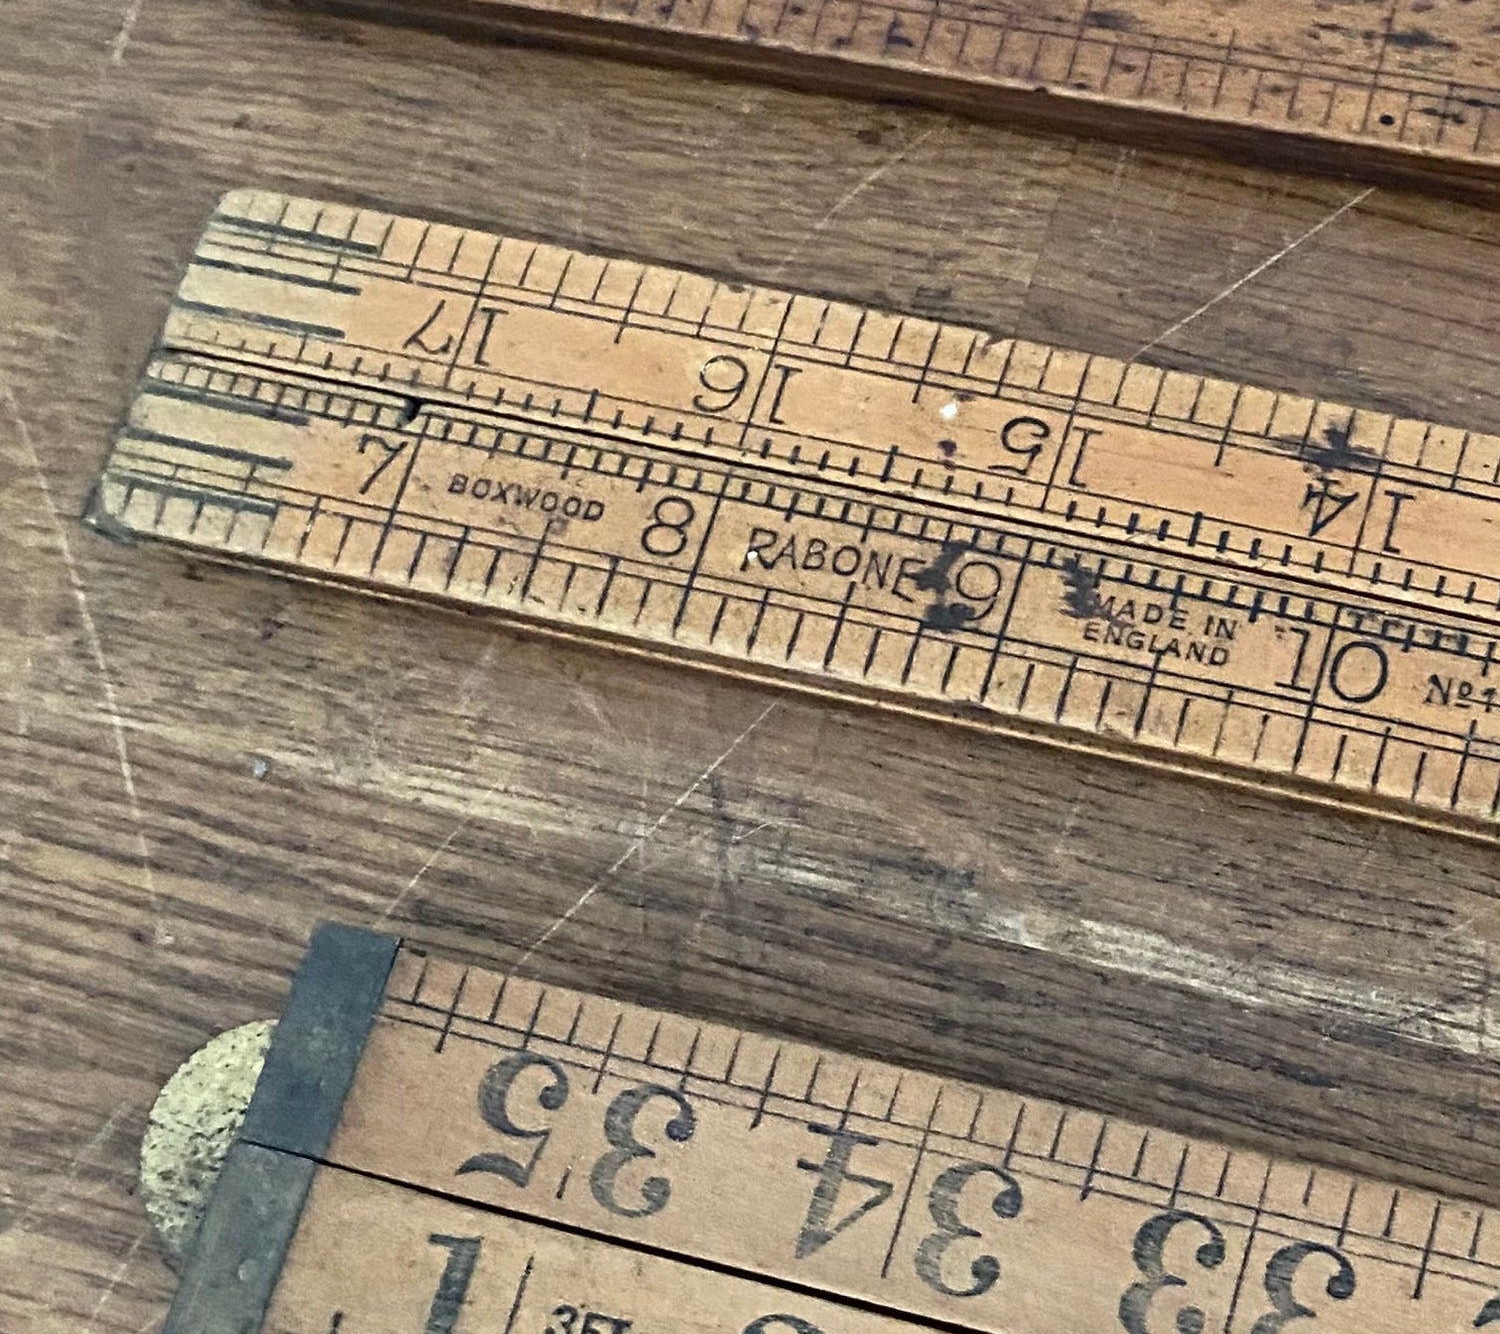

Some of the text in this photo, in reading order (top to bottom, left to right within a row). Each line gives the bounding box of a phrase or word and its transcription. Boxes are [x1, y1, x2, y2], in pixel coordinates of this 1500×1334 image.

[402, 298, 509, 369] 17
[691, 353, 803, 426] 16
[987, 415, 1103, 489] 15
[447, 471, 606, 524] BOXWOOD
[1302, 475, 1416, 555] 14
[356, 431, 409, 497] 7
[640, 494, 696, 558] 8
[953, 560, 1003, 624] 9
[1274, 624, 1390, 704] 10
[739, 526, 930, 604] RABONE
[1082, 620, 1231, 667] ENGLAND
[1094, 593, 1238, 641] MADE IN
[453, 1052, 698, 1219] 35
[795, 1122, 1024, 1298] 34
